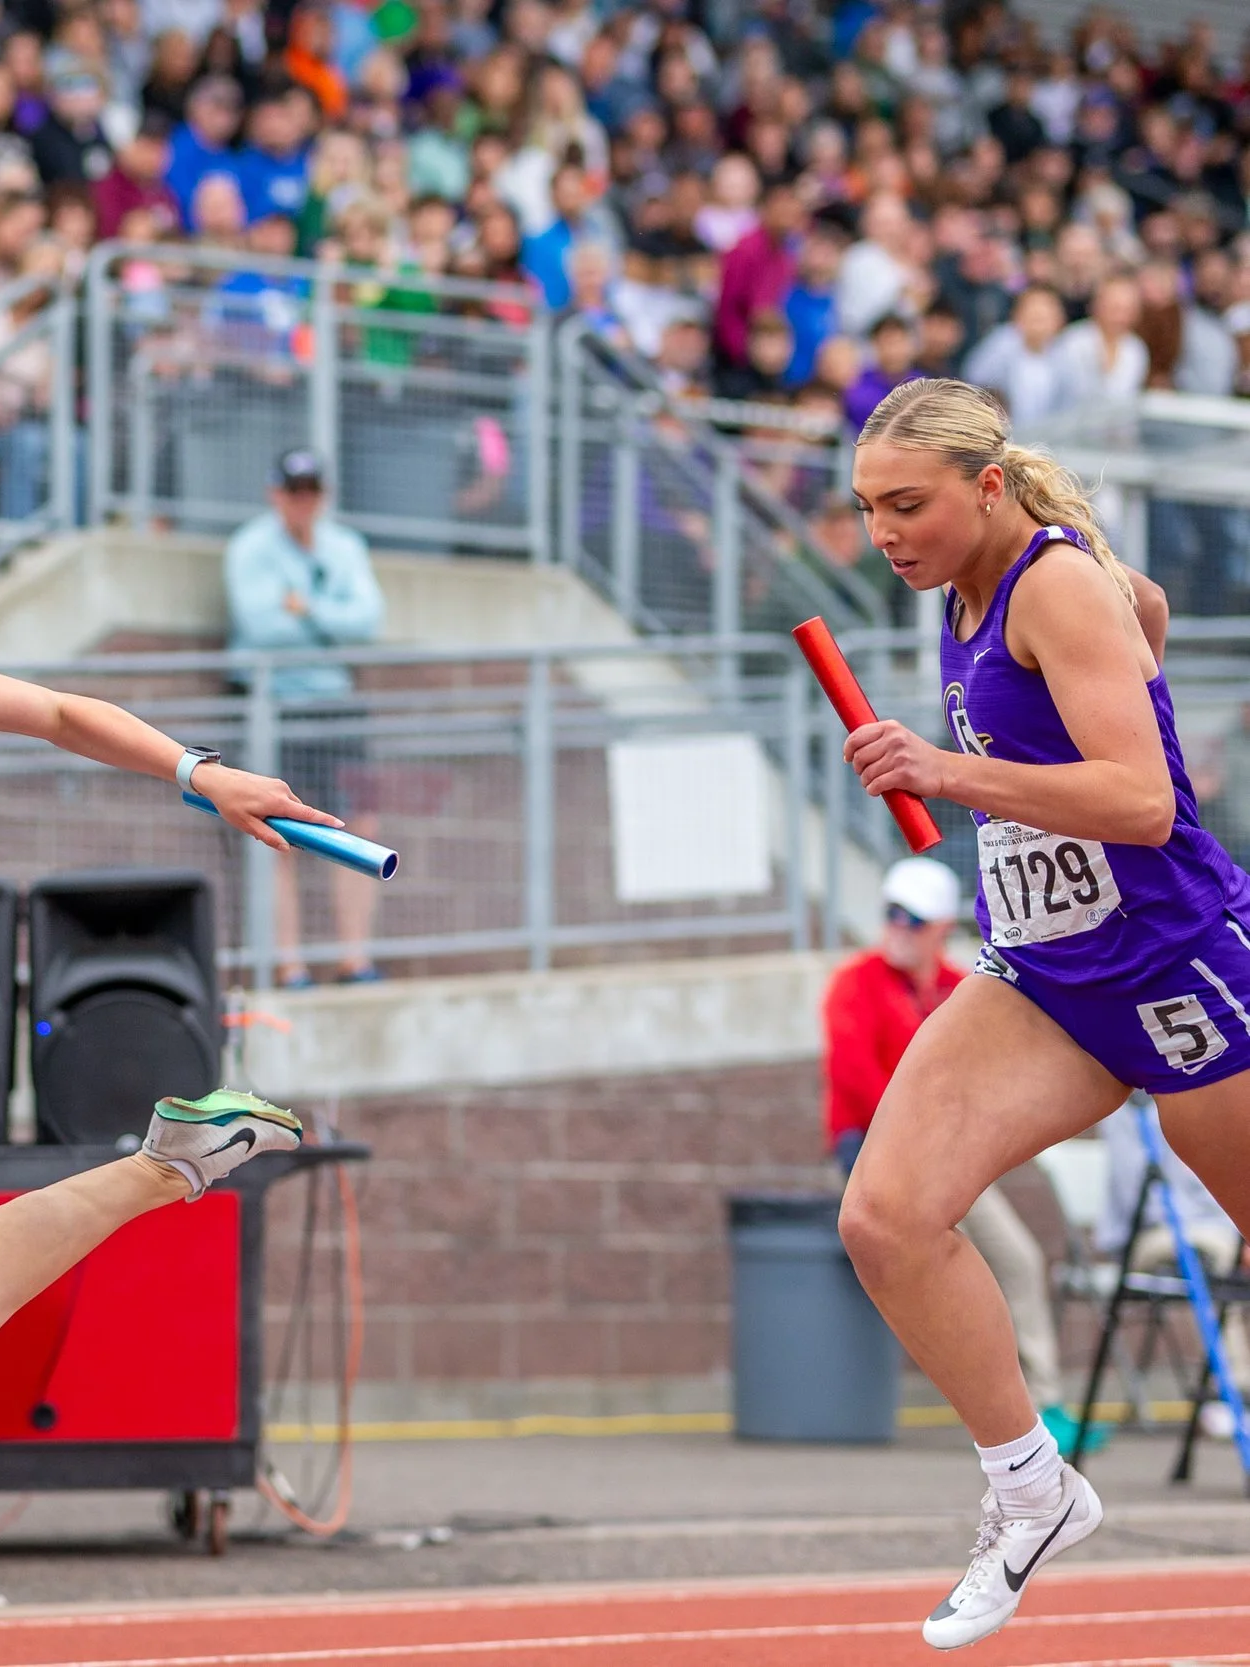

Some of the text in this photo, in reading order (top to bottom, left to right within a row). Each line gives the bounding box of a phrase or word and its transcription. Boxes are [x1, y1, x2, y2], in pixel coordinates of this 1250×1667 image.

[1004, 825, 1022, 835] 2025
[990, 841, 1100, 921] 1729
[1153, 1001, 1208, 1062] 5
